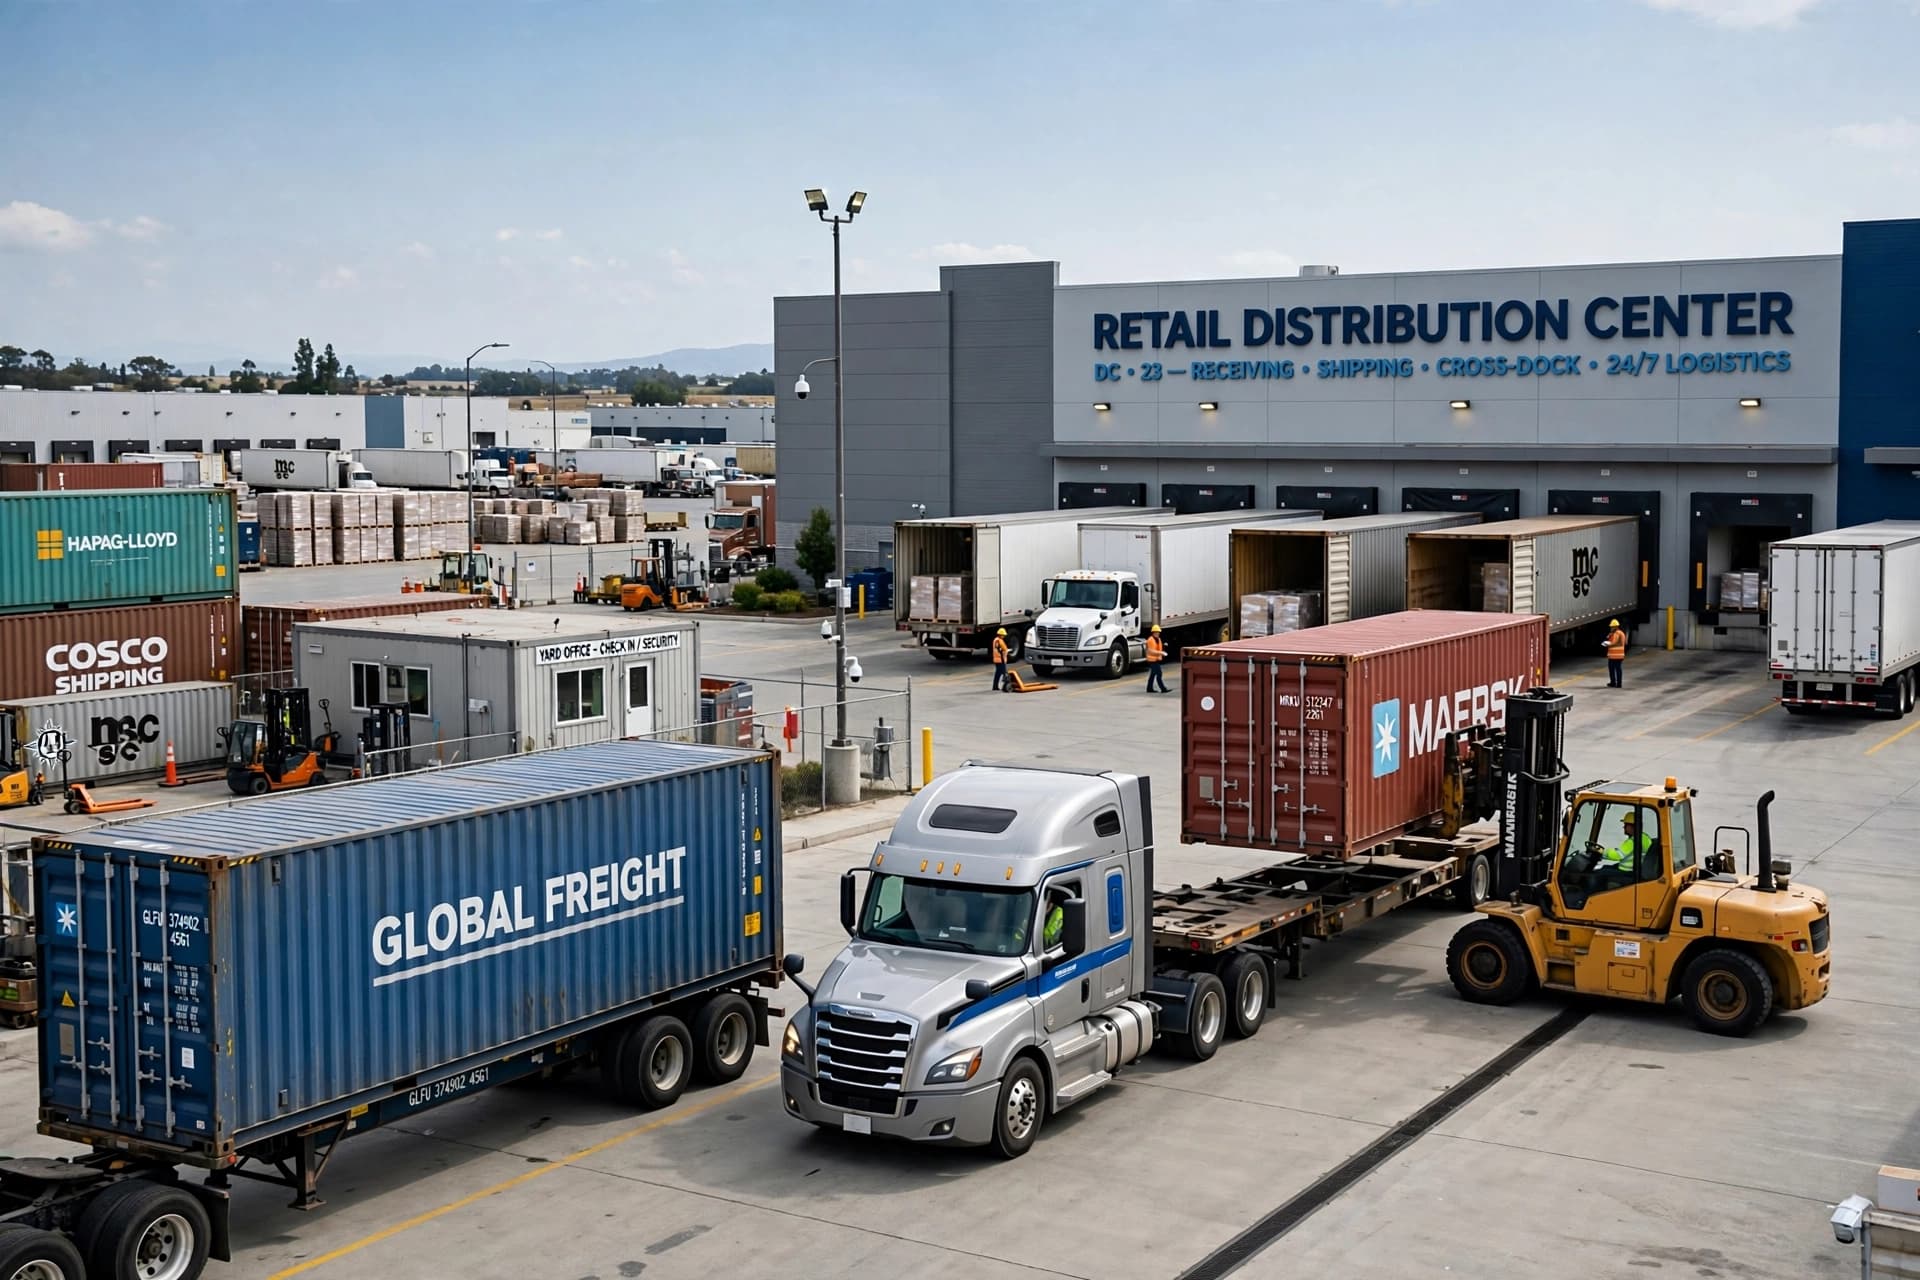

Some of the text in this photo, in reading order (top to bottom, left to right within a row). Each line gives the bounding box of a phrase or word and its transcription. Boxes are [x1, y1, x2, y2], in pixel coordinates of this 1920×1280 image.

[1094, 291, 1794, 349] RETAIL DISTRIBUTION CENTER
[1095, 362, 1121, 381] DC
[1140, 362, 1163, 381] 23
[1192, 359, 1294, 380] RECEIVING
[1317, 357, 1413, 378] SHIPPING
[1436, 353, 1581, 376] CROSS-DOCK
[1607, 351, 1659, 377] 24/7
[1665, 350, 1791, 374] LOGISTICS
[68, 532, 177, 551] HAPAG-LLOYD
[46, 636, 168, 672] COSCO
[539, 647, 561, 661] YARD
[628, 639, 636, 651] IN
[642, 634, 678, 649] SECURITY
[55, 666, 163, 695] SHIPPING
[373, 846, 686, 966] GLOBAL FREIGHT
[169, 913, 200, 931] 374902
[409, 1067, 489, 1106] GLFU 374902 45G1
